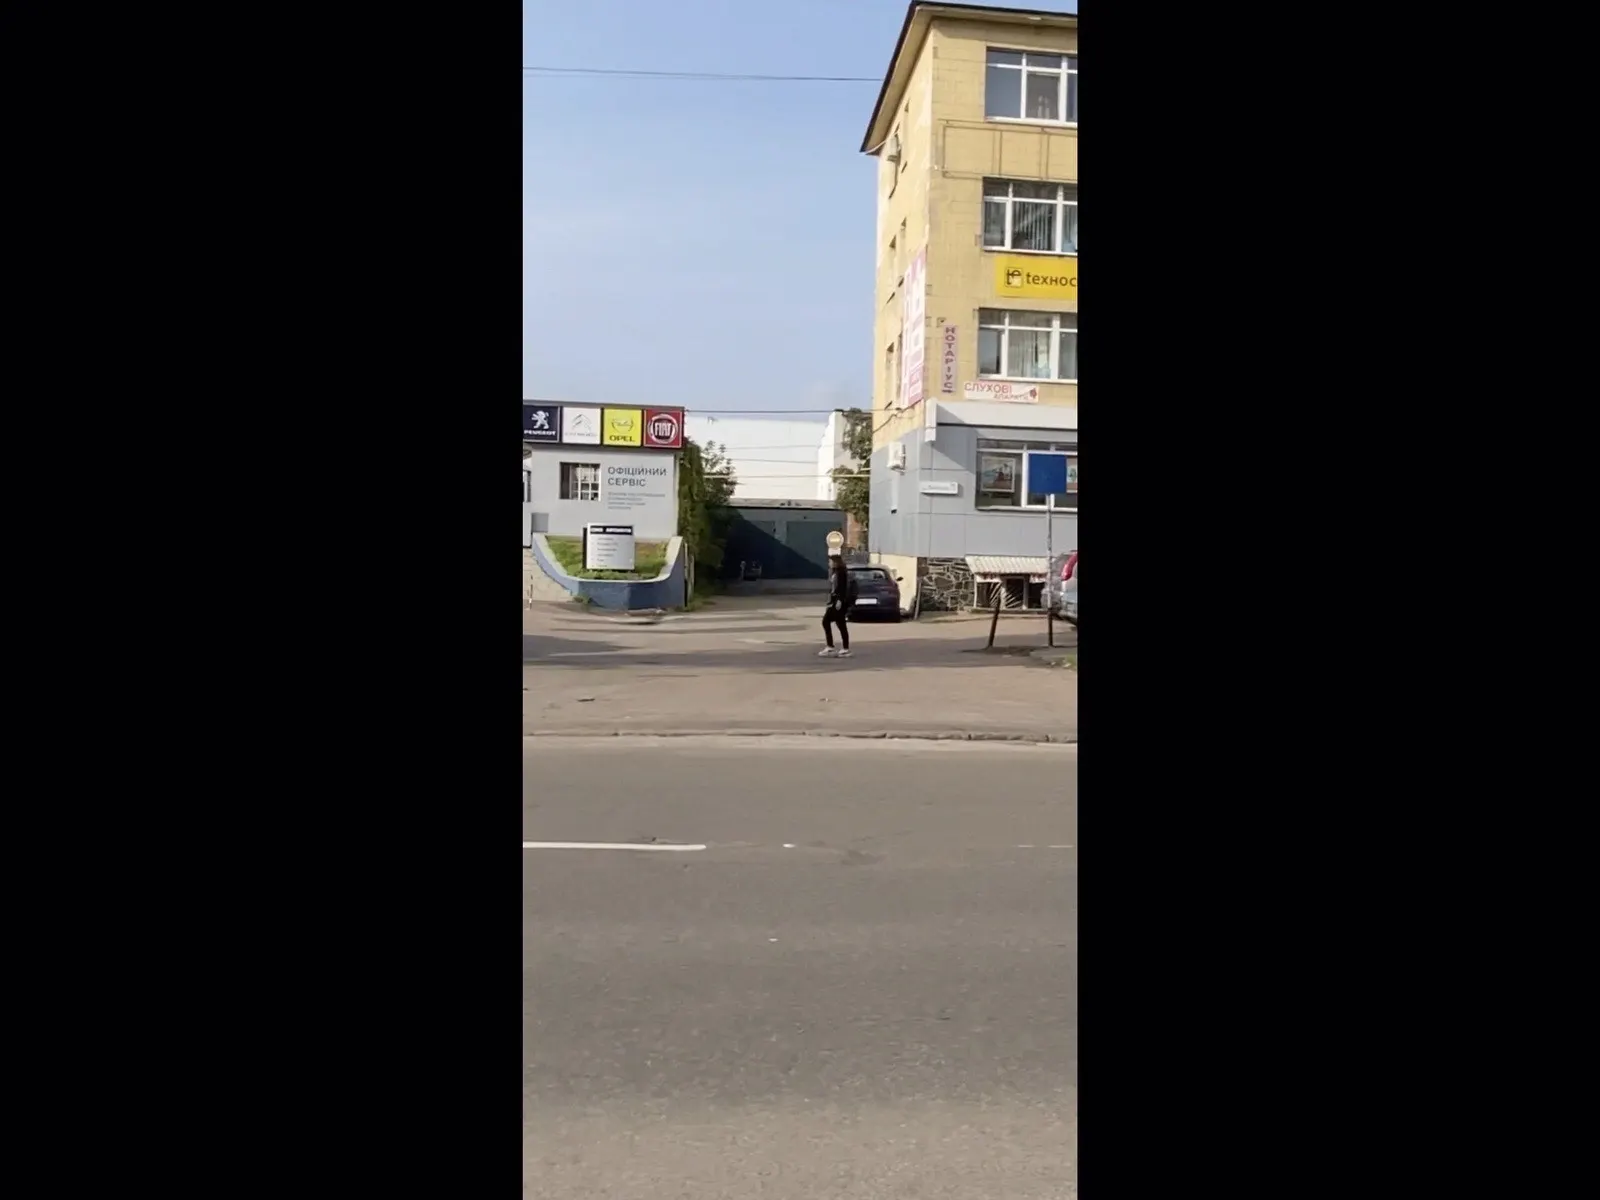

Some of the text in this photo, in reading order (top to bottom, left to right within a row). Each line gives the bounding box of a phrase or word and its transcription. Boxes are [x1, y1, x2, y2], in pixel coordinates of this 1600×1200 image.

[944, 326, 956, 389] НОТАРІУС
[964, 382, 1012, 394] СЛУХОВІ
[524, 429, 556, 437] PEUGEOT
[654, 422, 672, 437] FIAT
[609, 435, 636, 443] OPEL
[608, 477, 646, 487] СЕРВІС
